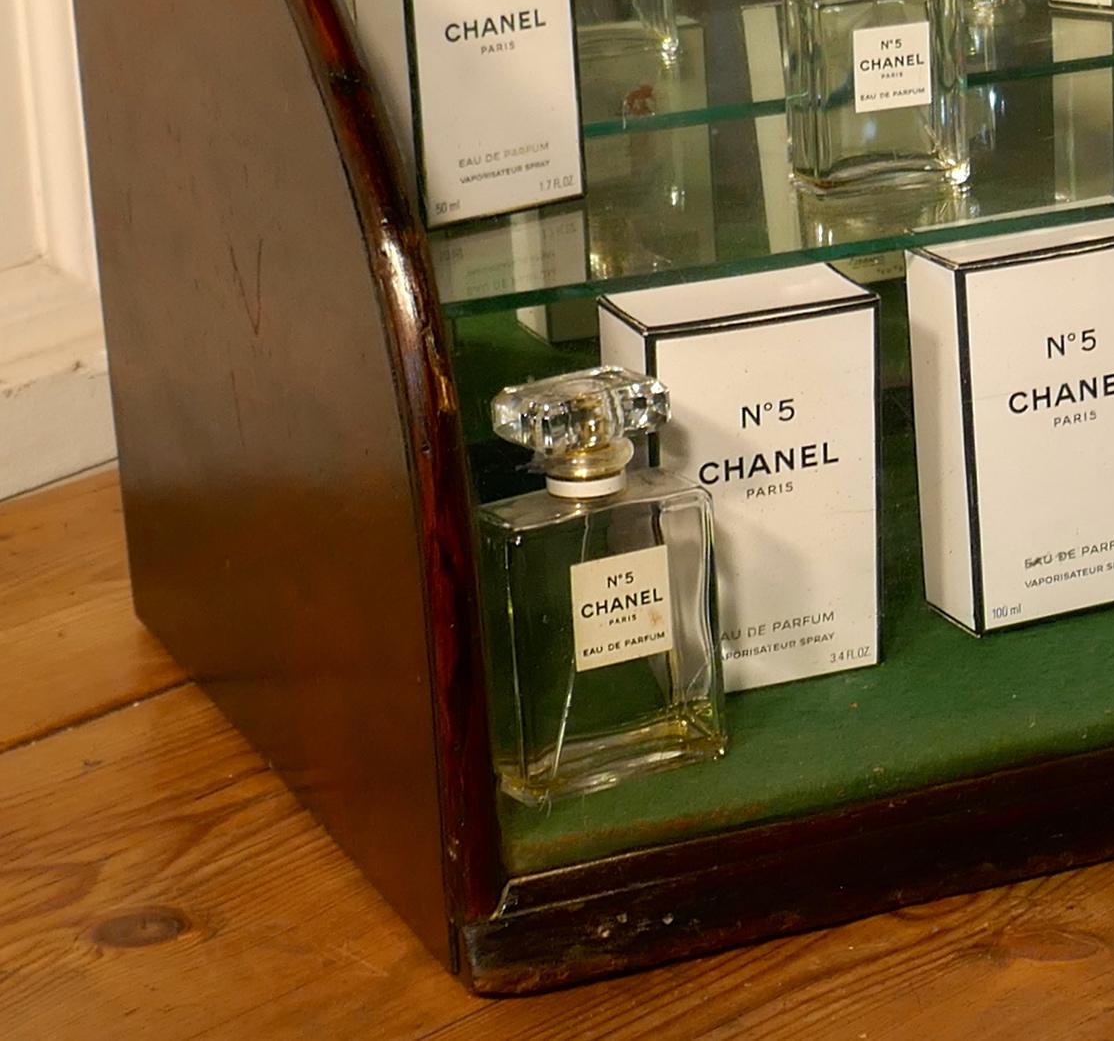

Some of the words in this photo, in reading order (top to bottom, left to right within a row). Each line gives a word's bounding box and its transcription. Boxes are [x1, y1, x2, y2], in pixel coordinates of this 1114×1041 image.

[444, 8, 547, 43] CHANEL
[480, 41, 516, 55] PARIS
[860, 53, 924, 72] CHANEL
[893, 87, 925, 97] PARFUM
[458, 153, 482, 169] EAU
[484, 150, 501, 164] DE
[503, 141, 550, 160] PARFUM
[459, 164, 524, 184] VAPORISATEUR
[525, 160, 551, 171] SPRAY
[435, 202, 449, 216] 50
[449, 199, 461, 211] ml
[1054, 410, 1097, 428] PARIS
[699, 442, 839, 485] CHANEL
[747, 481, 794, 499] PARIS
[1024, 553, 1052, 570] EAU
[1058, 548, 1077, 562] DE
[1024, 564, 1104, 589] VAPORISATEUR
[581, 588, 663, 618] CHANEL
[992, 605, 1009, 619] 100
[1009, 603, 1022, 616] ml
[609, 614, 637, 626] PARIS
[720, 627, 742, 642] AU
[747, 623, 766, 638] DE
[773, 611, 835, 633] PARFUM
[583, 646, 603, 657] EAU
[608, 641, 621, 652] DE
[625, 631, 665, 647] PARFUM
[724, 640, 797, 661] PORISATEUR
[800, 632, 835, 648] SPRAY
[830, 650, 845, 664] 3.4
